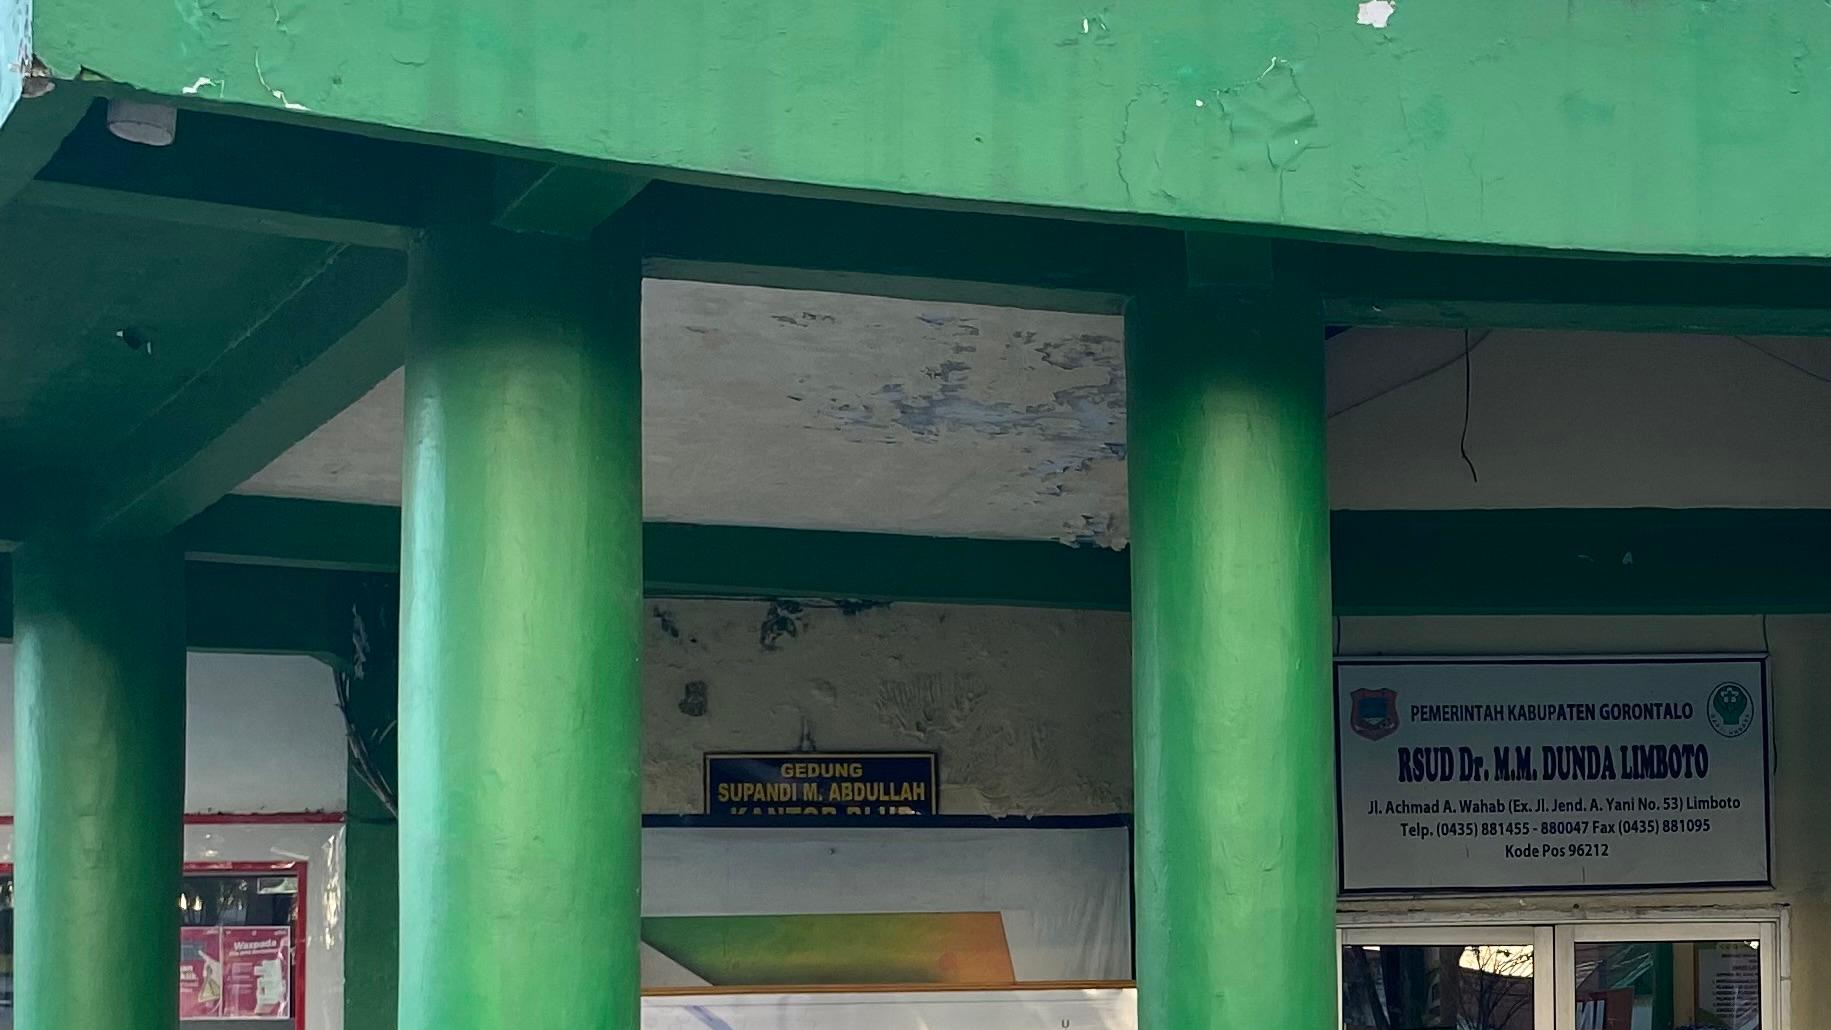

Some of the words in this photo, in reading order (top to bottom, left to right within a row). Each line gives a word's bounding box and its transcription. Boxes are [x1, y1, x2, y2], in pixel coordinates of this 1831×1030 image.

[1411, 704, 1504, 721] PEMERINTAH
[1507, 703, 1596, 721] KABUPATEN
[1600, 703, 1694, 720] GORONTALO
[780, 763, 863, 778] GEDUNG
[1398, 747, 1454, 782] RSUD
[1458, 746, 1489, 782] Dr.
[1493, 746, 1538, 781] M.M.
[1542, 745, 1617, 780] DUNDA
[1620, 744, 1709, 779] LIMBOTO
[718, 783, 797, 801] SUPANDI
[803, 782, 822, 801] M.
[829, 782, 925, 801] ABDULLAH
[1368, 801, 1382, 814] Jl.
[1386, 800, 1440, 814] Achmad
[1443, 800, 1456, 814] A.
[1459, 799, 1505, 813] Wahab
[1508, 800, 1532, 814] (Ex.
[1535, 800, 1549, 813] Jl.
[1551, 799, 1587, 812] Jend.
[1590, 798, 1602, 812] A.
[1606, 798, 1635, 811] Yani
[1638, 797, 1660, 811] No.
[1663, 797, 1684, 812] 53)
[1687, 795, 1741, 810] Limboto
[1401, 823, 1433, 840] Telp.
[1436, 822, 1478, 838] (0435)
[1482, 822, 1530, 836] 881455
[1541, 821, 1589, 835] 880047
[1592, 820, 1616, 834] Fax
[1619, 820, 1660, 836] (0435)
[1663, 819, 1711, 833] 881095
[1505, 843, 1540, 858] Kode
[1543, 844, 1566, 857] Pos
[1568, 843, 1609, 857] 96212
